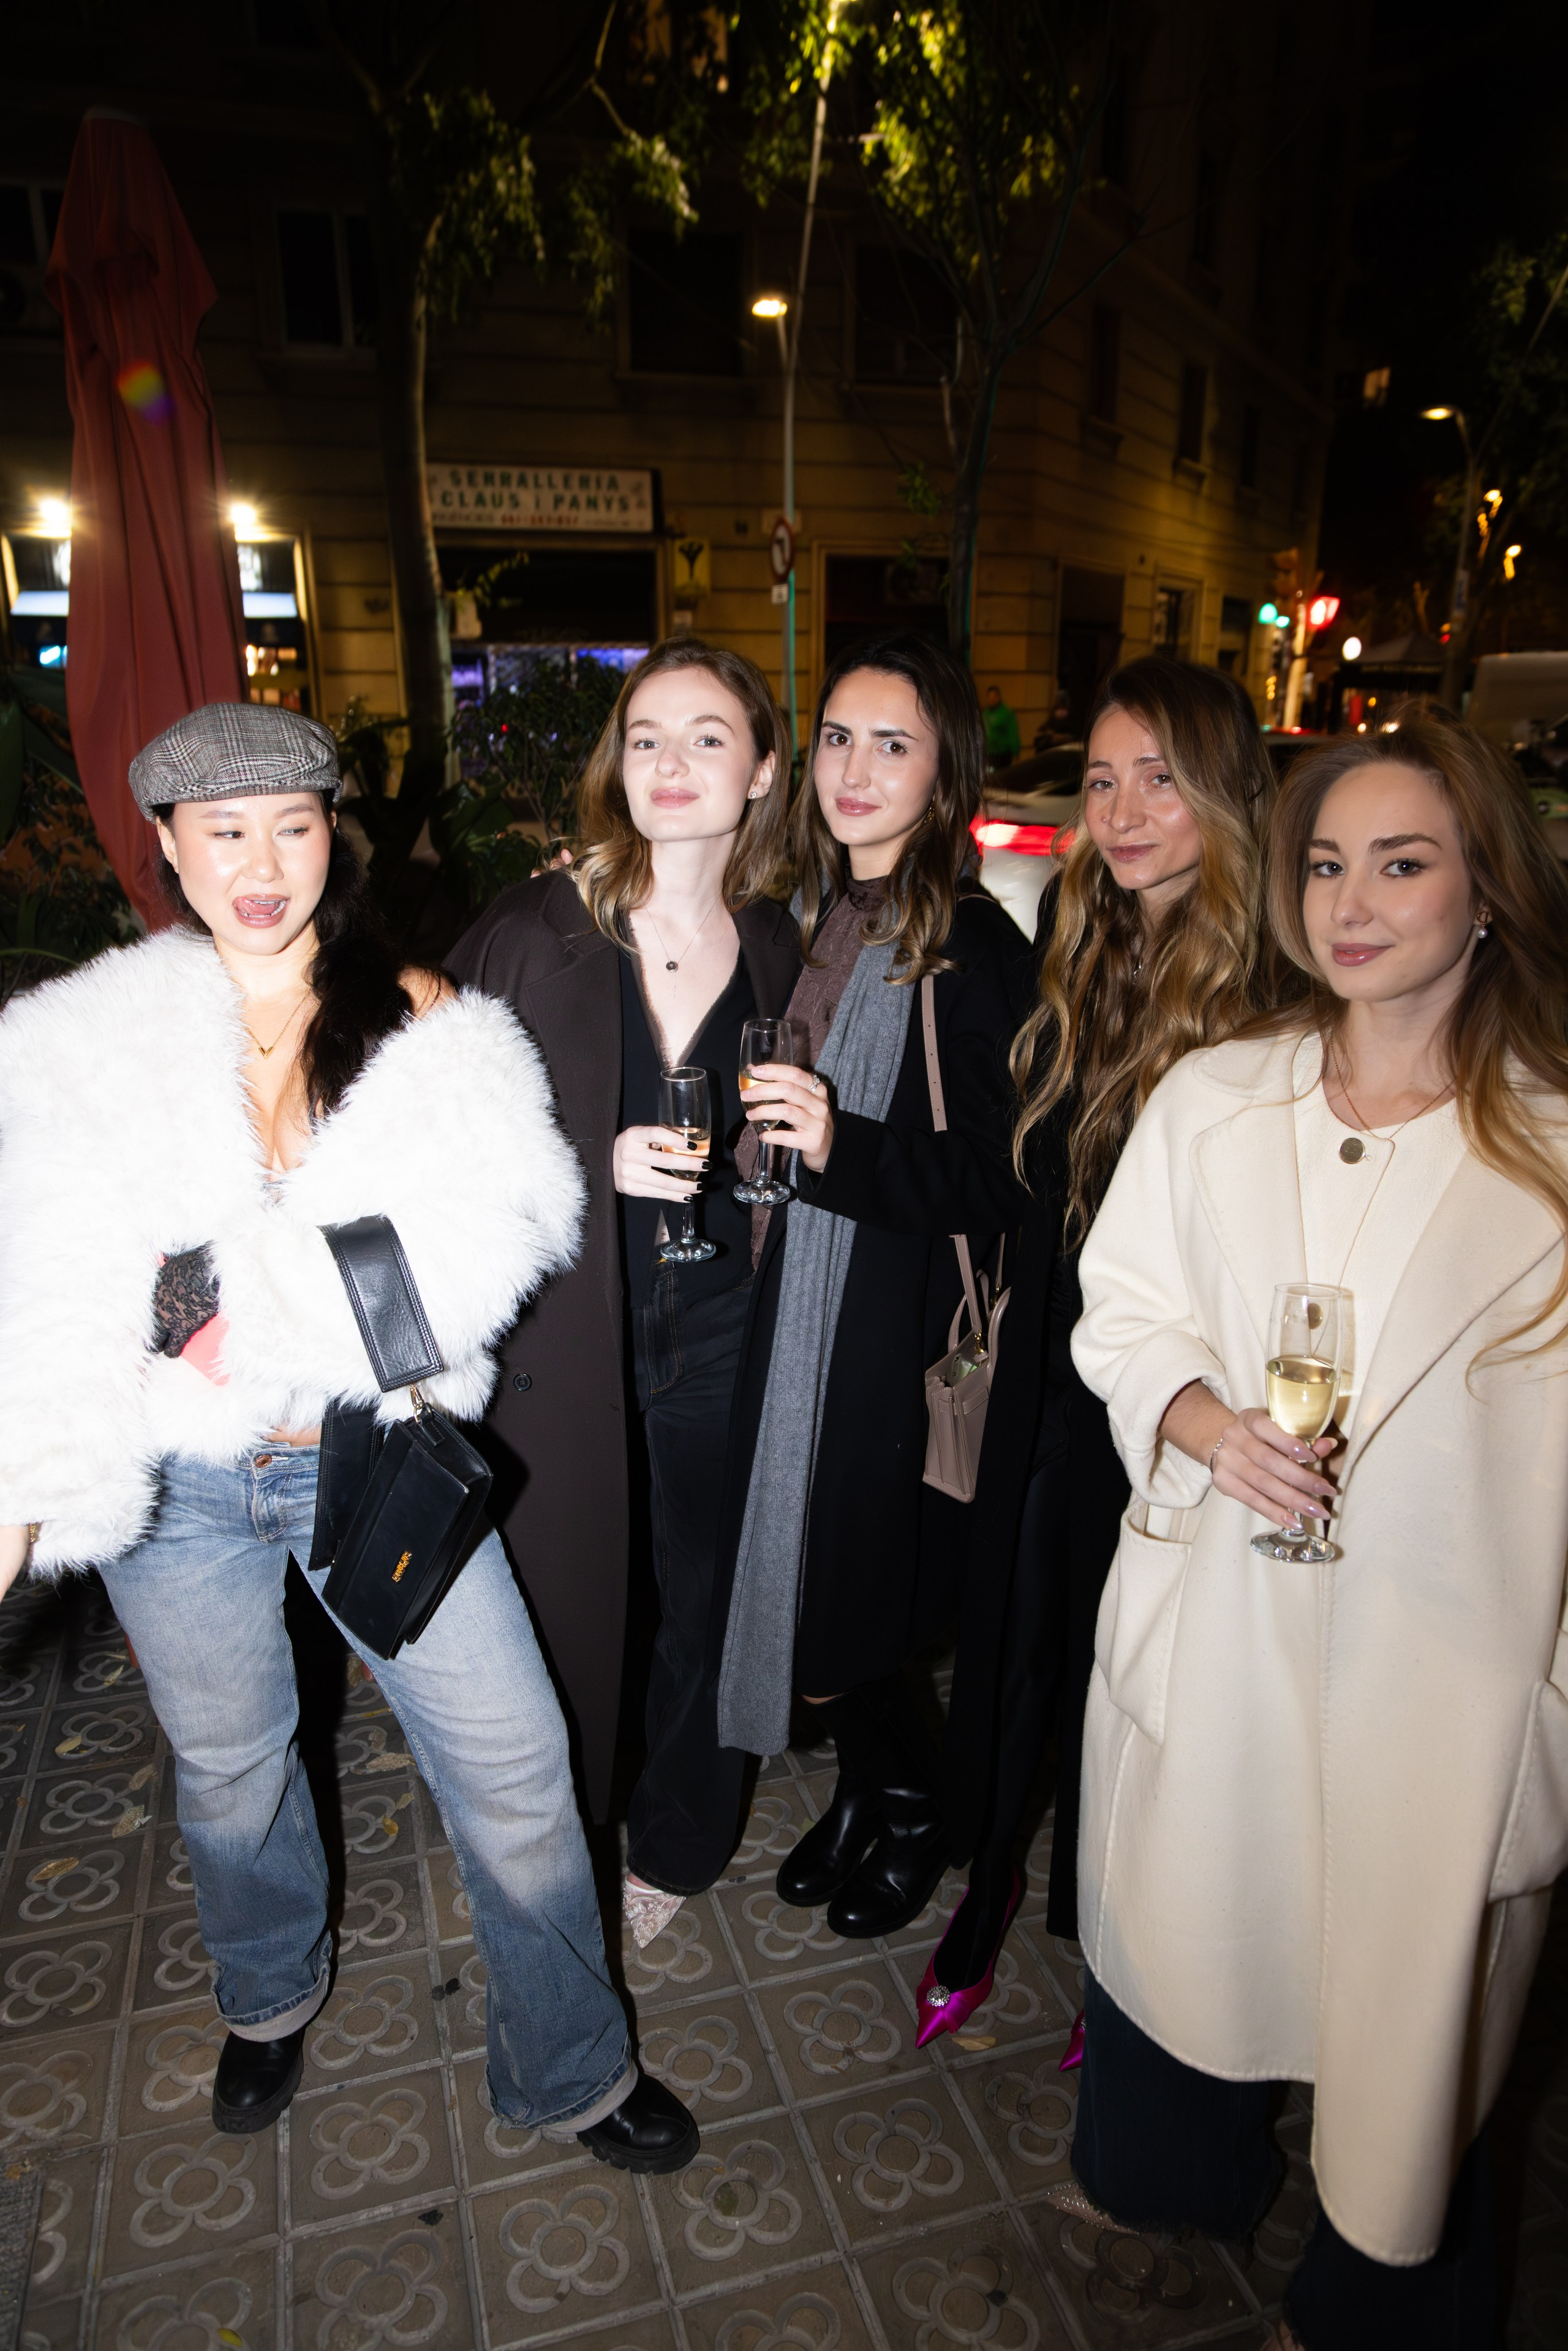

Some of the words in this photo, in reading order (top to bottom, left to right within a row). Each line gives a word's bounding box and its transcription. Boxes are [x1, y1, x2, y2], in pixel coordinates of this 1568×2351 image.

[450, 469, 619, 491] SERRALLERIA
[441, 491, 520, 509] CLAUS
[553, 494, 630, 513] PANYS
